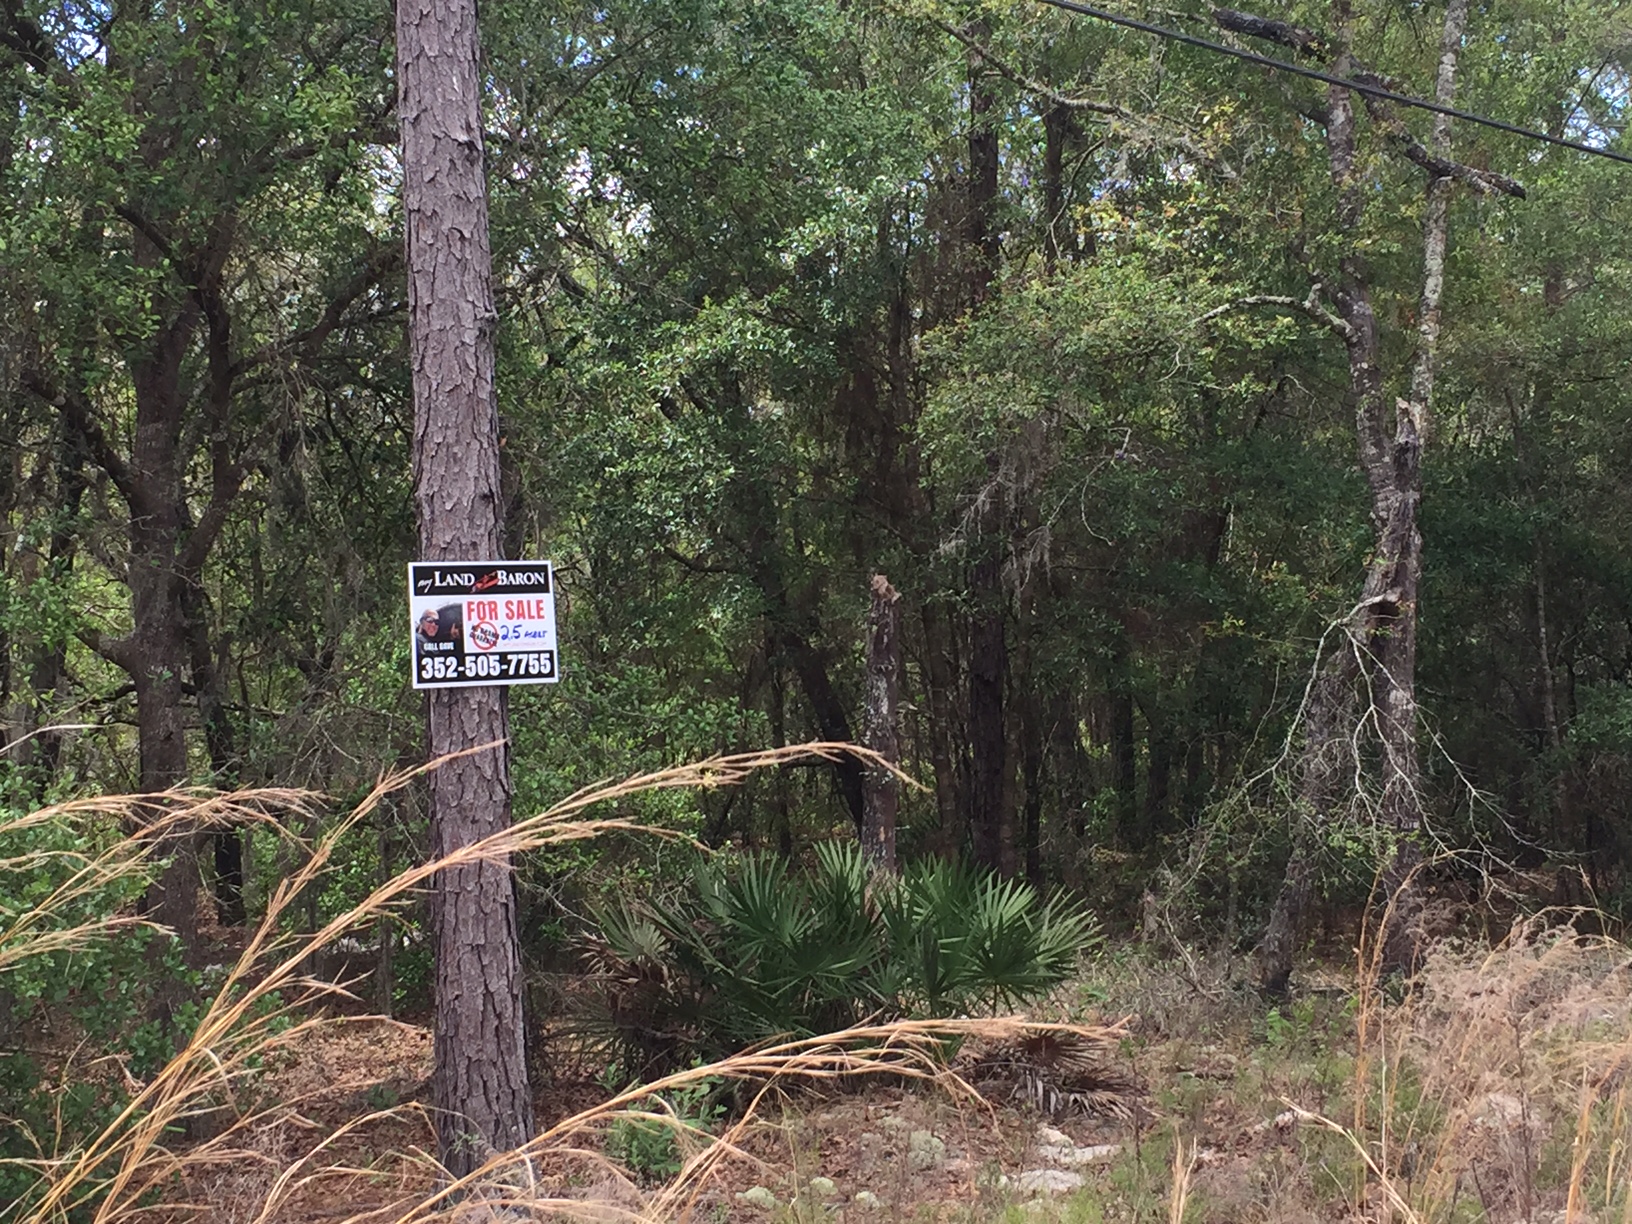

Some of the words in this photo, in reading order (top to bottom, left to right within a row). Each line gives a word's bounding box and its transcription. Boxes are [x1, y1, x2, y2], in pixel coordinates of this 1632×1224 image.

[467, 600, 498, 621] FOR
[505, 599, 545, 620] SALE
[421, 653, 551, 679] 352-505-7755
